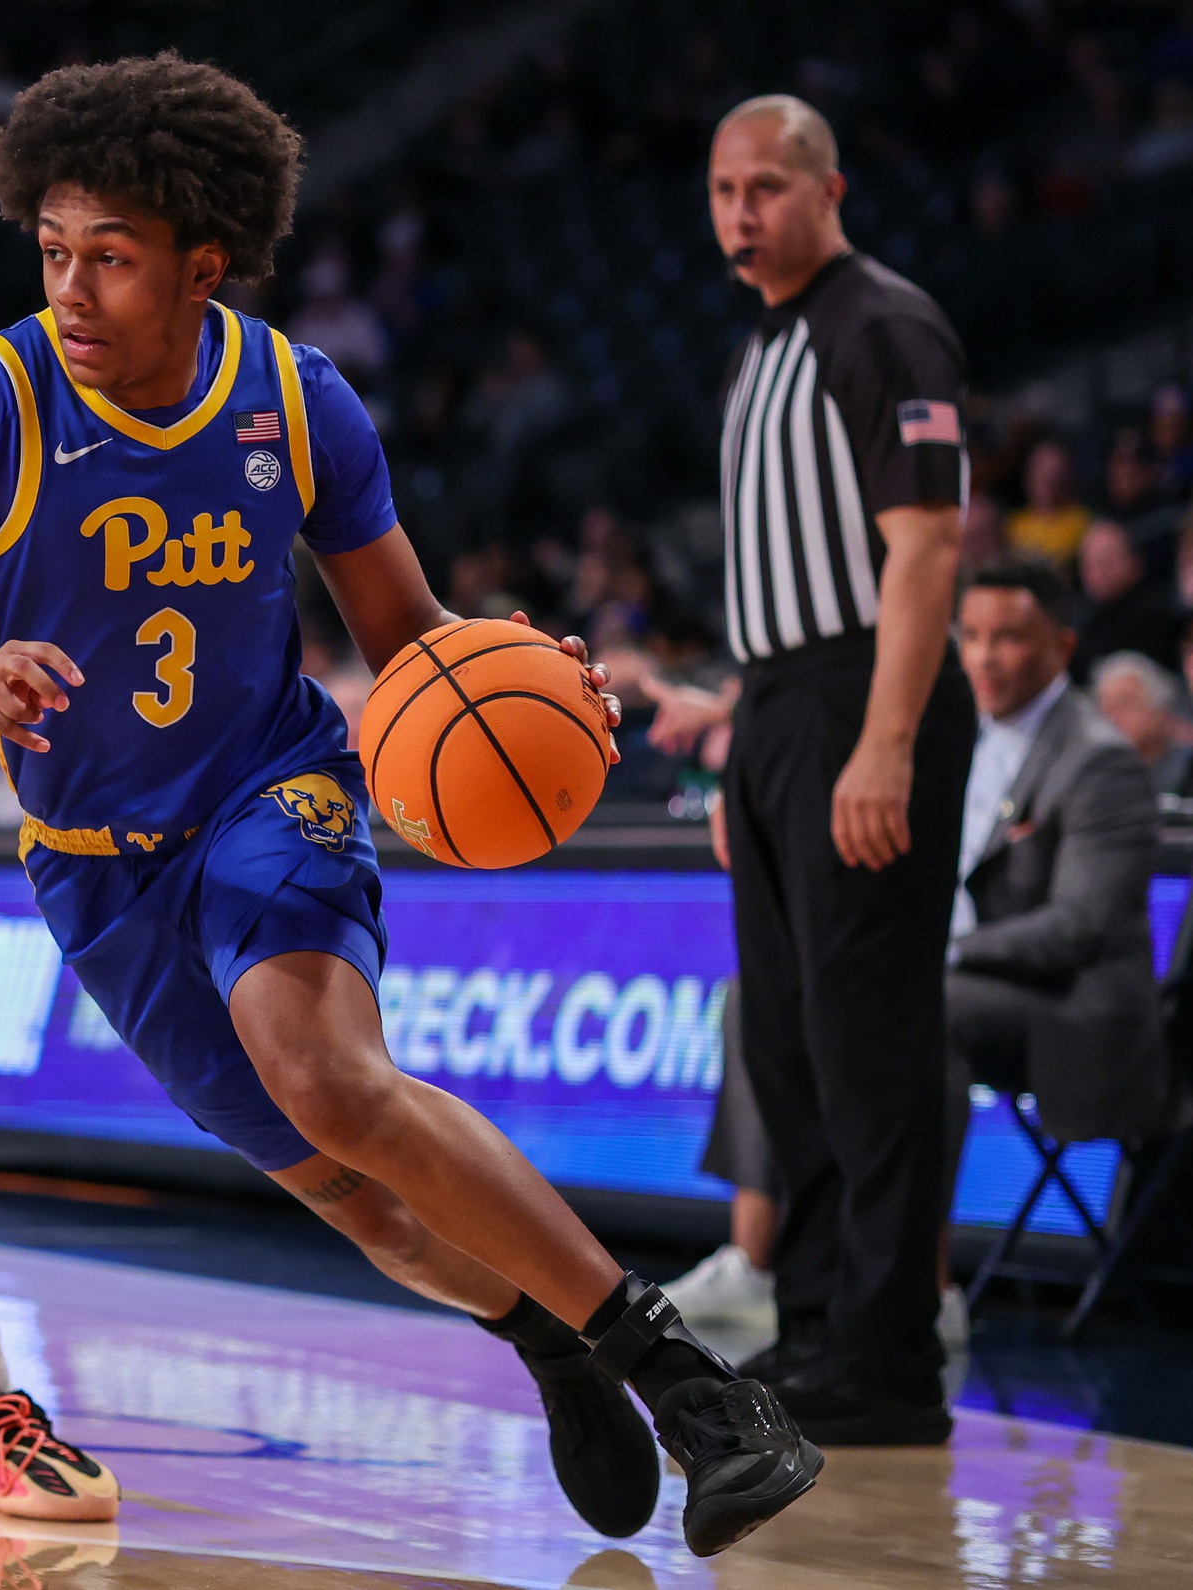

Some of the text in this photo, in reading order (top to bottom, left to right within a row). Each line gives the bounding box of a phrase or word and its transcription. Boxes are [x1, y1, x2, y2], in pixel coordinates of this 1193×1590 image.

[251, 463, 277, 474] ACC
[80, 496, 255, 591] Pitt
[132, 606, 197, 729] 3
